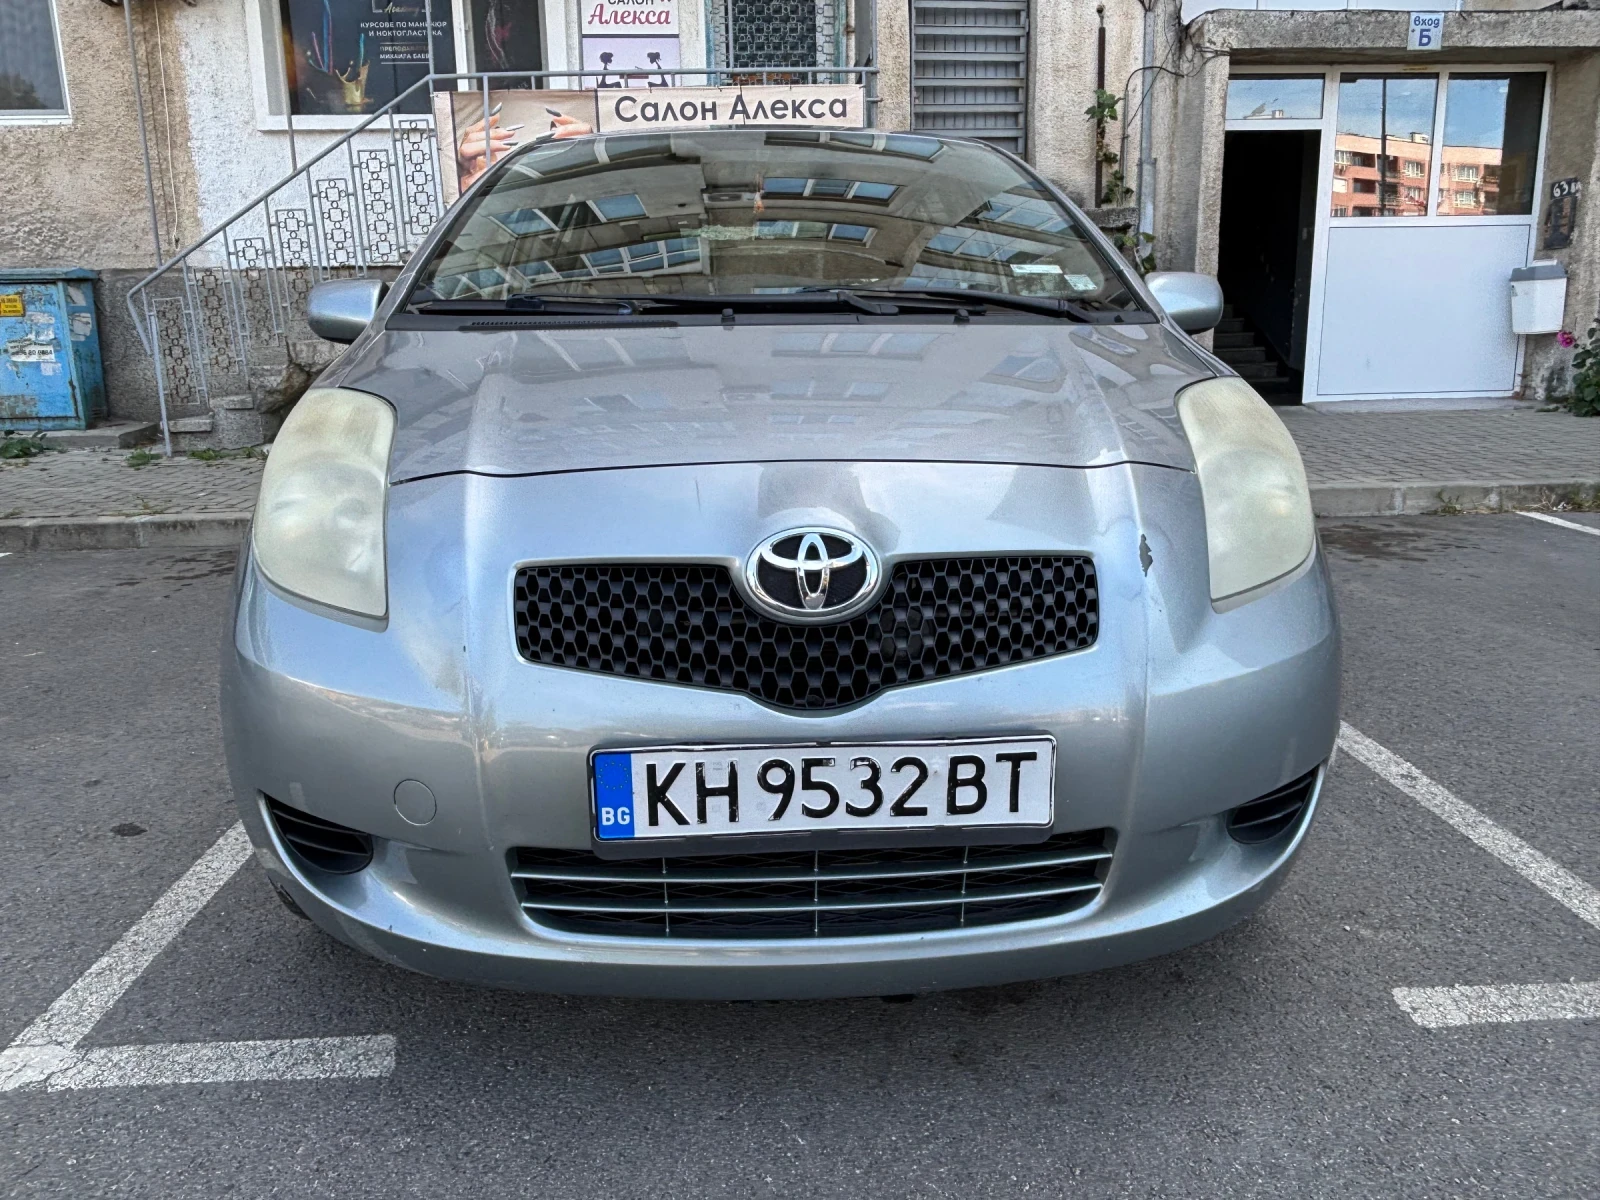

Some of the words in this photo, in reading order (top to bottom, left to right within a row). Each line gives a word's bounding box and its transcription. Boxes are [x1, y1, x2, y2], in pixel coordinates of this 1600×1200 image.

[588, 3, 671, 25] Алекса
[1418, 29, 1431, 46] Б
[614, 95, 718, 122] Салон
[729, 93, 847, 120] Алекса
[646, 760, 739, 827] KH
[757, 756, 928, 822] 9532
[947, 751, 1038, 816] BT
[601, 807, 630, 826] BG
